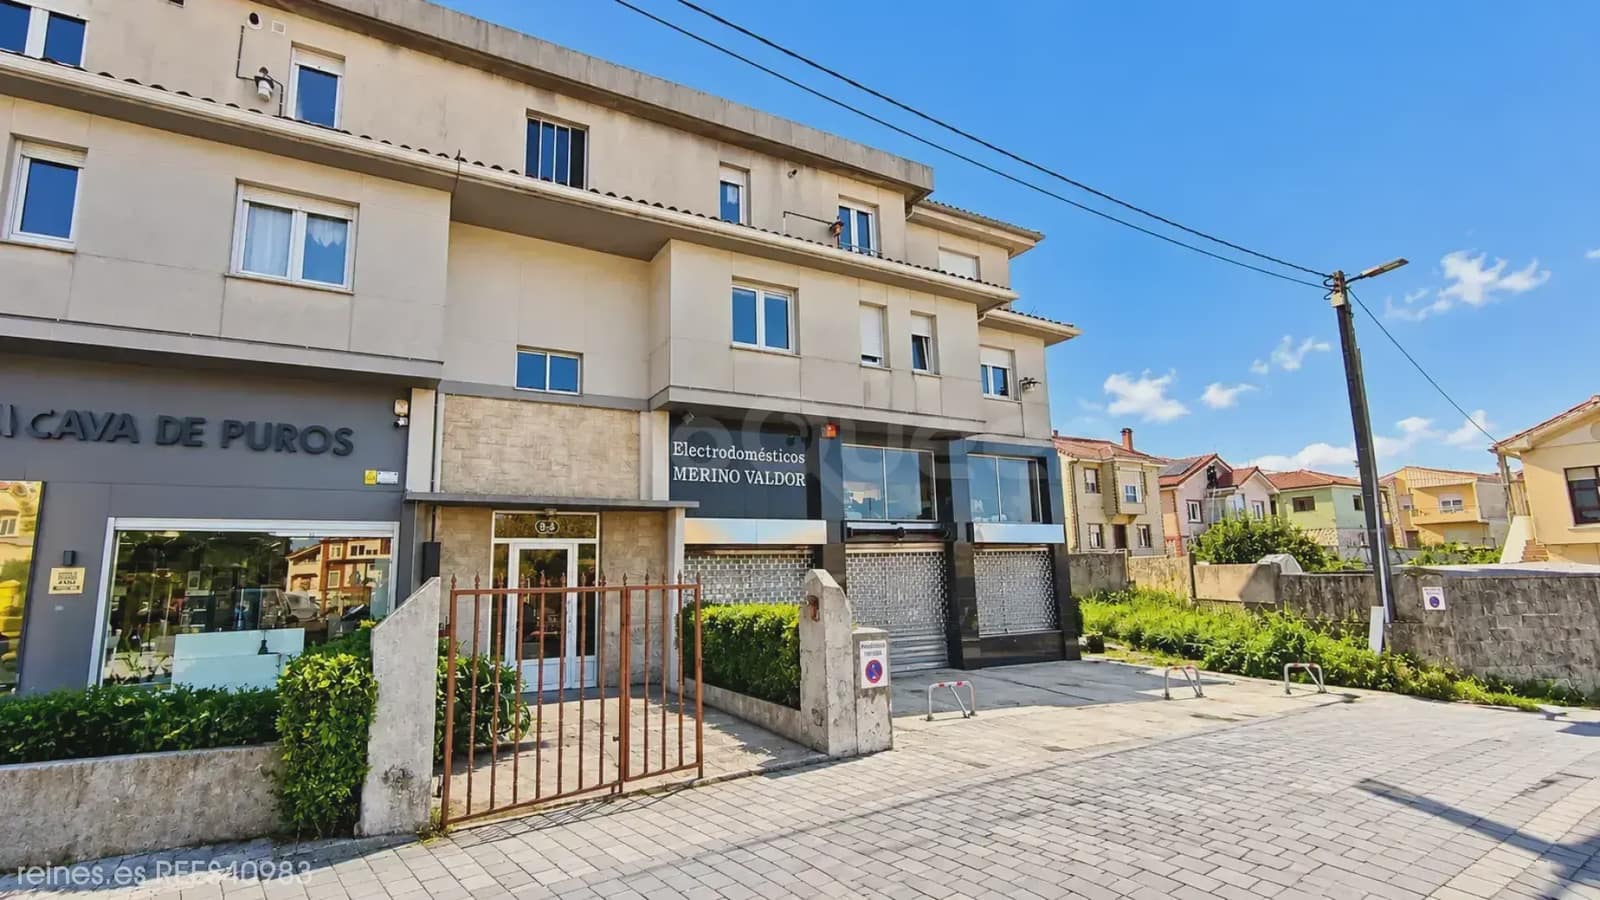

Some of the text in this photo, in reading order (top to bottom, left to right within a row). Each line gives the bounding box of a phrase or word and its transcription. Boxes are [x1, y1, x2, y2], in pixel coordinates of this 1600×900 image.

[28, 410, 139, 443] CAVA
[155, 415, 208, 448] DE
[220, 419, 355, 457] PUROS
[672, 441, 806, 464] Electrodomésticos
[672, 466, 807, 487] MERINO VALDOR
